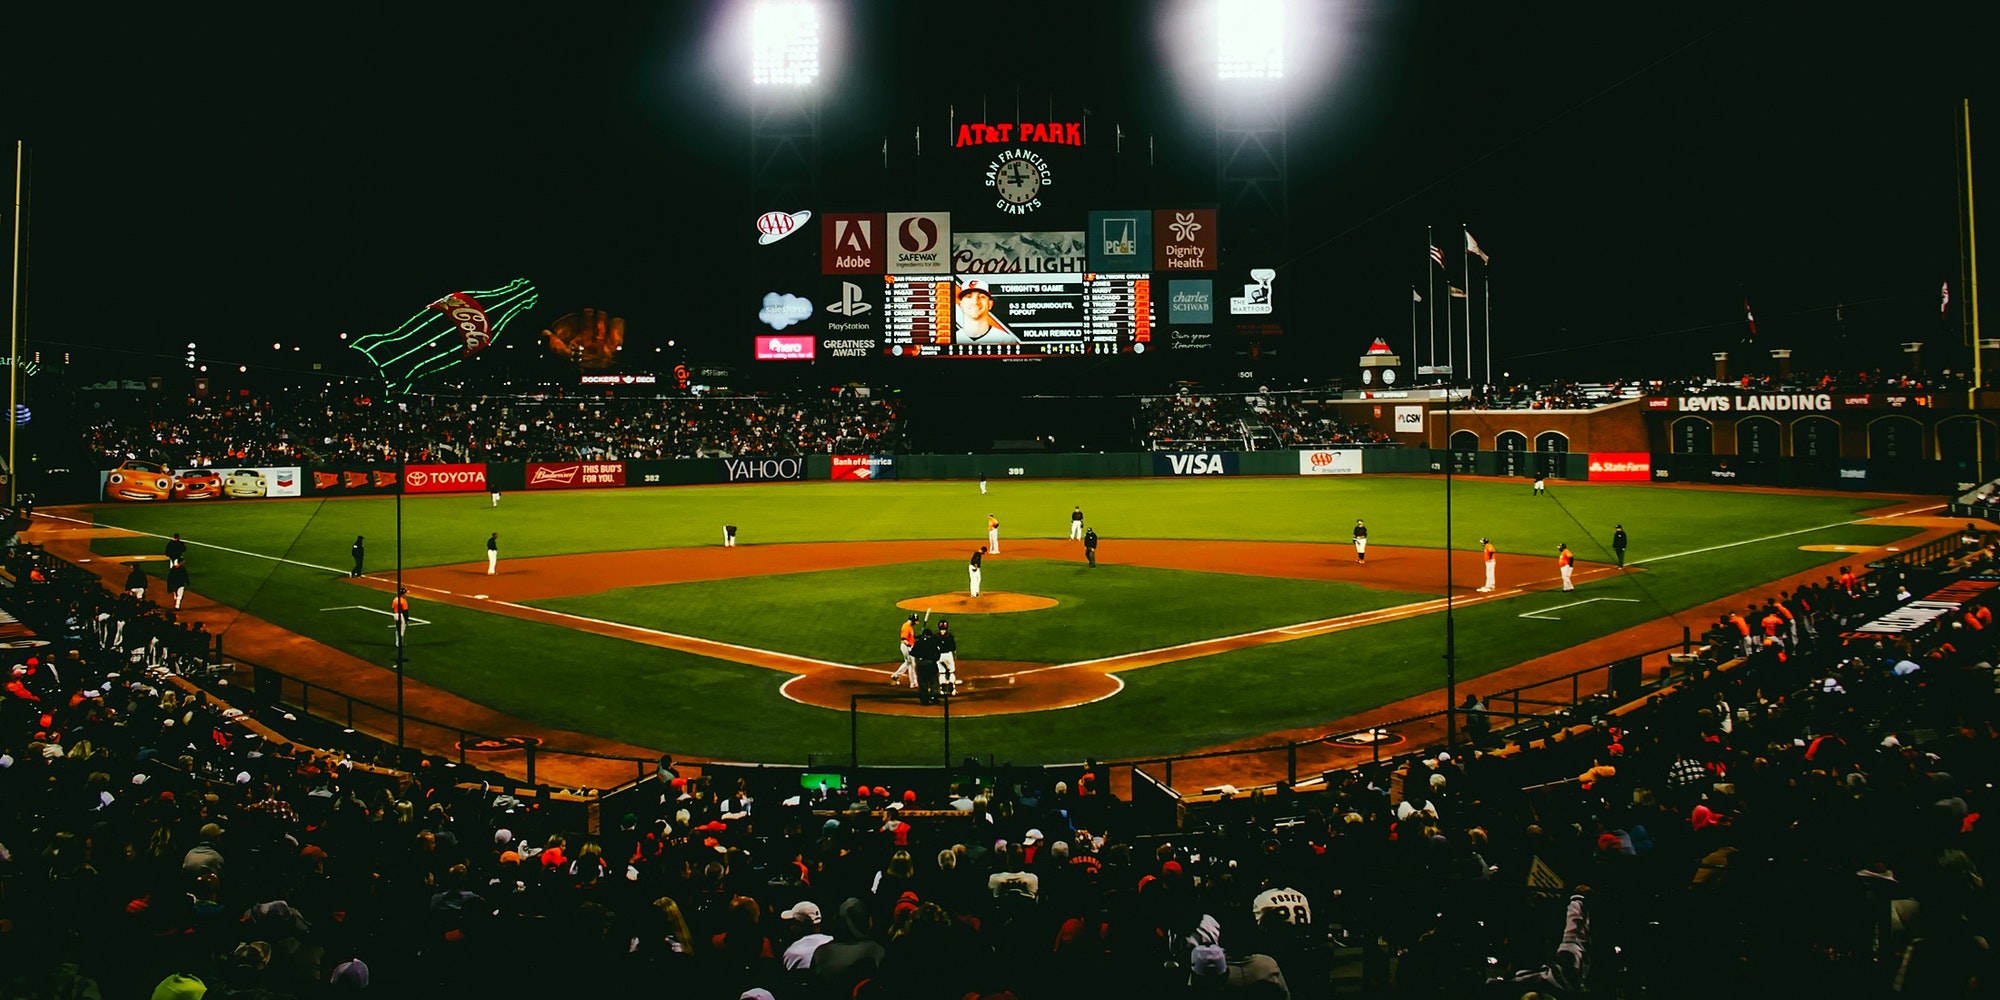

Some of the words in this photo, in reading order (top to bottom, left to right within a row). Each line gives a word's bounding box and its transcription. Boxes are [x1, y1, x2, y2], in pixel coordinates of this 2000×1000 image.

[956, 123, 1013, 148] AT&T
[1019, 122, 1082, 146] PARK
[985, 161, 1000, 186] SAN
[998, 148, 1052, 186] FRANCISCO
[996, 198, 1041, 215] GIANTS
[760, 213, 793, 235] AAA
[1105, 240, 1135, 254] PG&E
[1166, 245, 1205, 257] Dignity
[835, 256, 871, 268] Adobe
[898, 253, 938, 262] SAFEWAY
[954, 250, 1022, 274] Coors
[1025, 257, 1085, 273] LIGHT
[1168, 258, 1204, 268] Health
[1000, 285, 1040, 293] TONIGHT'S
[1041, 284, 1064, 292] GAME
[1173, 291, 1208, 303] charles
[1172, 303, 1209, 311] SCHWAB
[828, 322, 870, 331] PlayStation
[1049, 329, 1082, 337] REIMOLD
[823, 340, 875, 349] GREATNESS
[832, 349, 867, 357] AWAITS
[1735, 395, 1832, 411] LANDING
[1406, 414, 1420, 423] CSN
[834, 457, 852, 466] Bank
[853, 458, 861, 466] of
[862, 457, 892, 466] America
[1165, 454, 1224, 474] VISA
[583, 465, 599, 473] THIS
[600, 465, 622, 473] BUD'S
[725, 458, 802, 481] YAHOO!
[1603, 463, 1626, 472] State
[1627, 463, 1649, 472] Farm
[430, 471, 486, 484] TOYOTA
[583, 474, 597, 483] FOR
[598, 474, 614, 483] YOU.
[1271, 894, 1302, 904] POSEY
